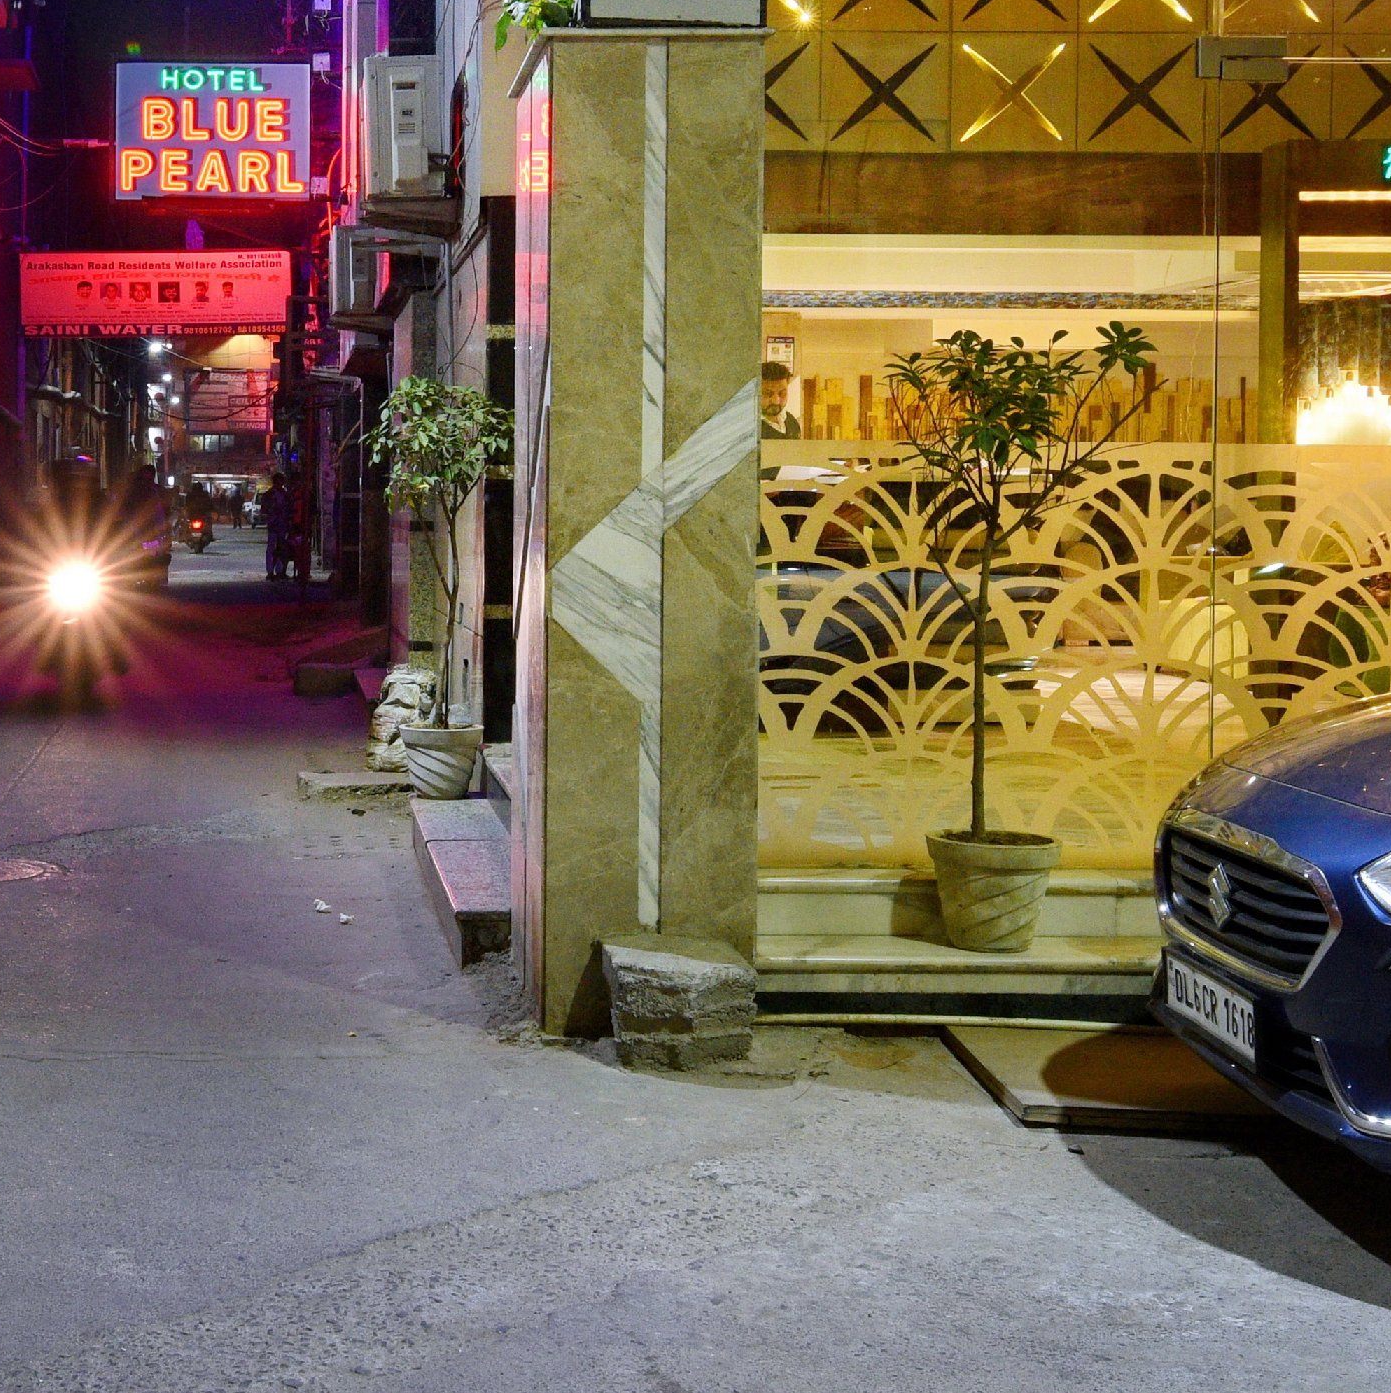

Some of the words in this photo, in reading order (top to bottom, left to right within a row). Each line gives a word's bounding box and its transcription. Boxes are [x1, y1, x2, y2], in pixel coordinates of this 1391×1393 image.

[161, 67, 264, 93] HOTEL
[141, 96, 287, 143] BLUE
[119, 147, 306, 193] PEARL
[26, 261, 83, 270] Arakashan
[88, 261, 115, 270] Road
[119, 261, 171, 270] Residents
[175, 261, 217, 270] Welfare
[220, 259, 282, 269] Association
[24, 325, 89, 335] SAINI
[98, 324, 183, 335] WATER
[1174, 968, 1219, 1026] DL6CR
[1223, 997, 1256, 1049] 1618
